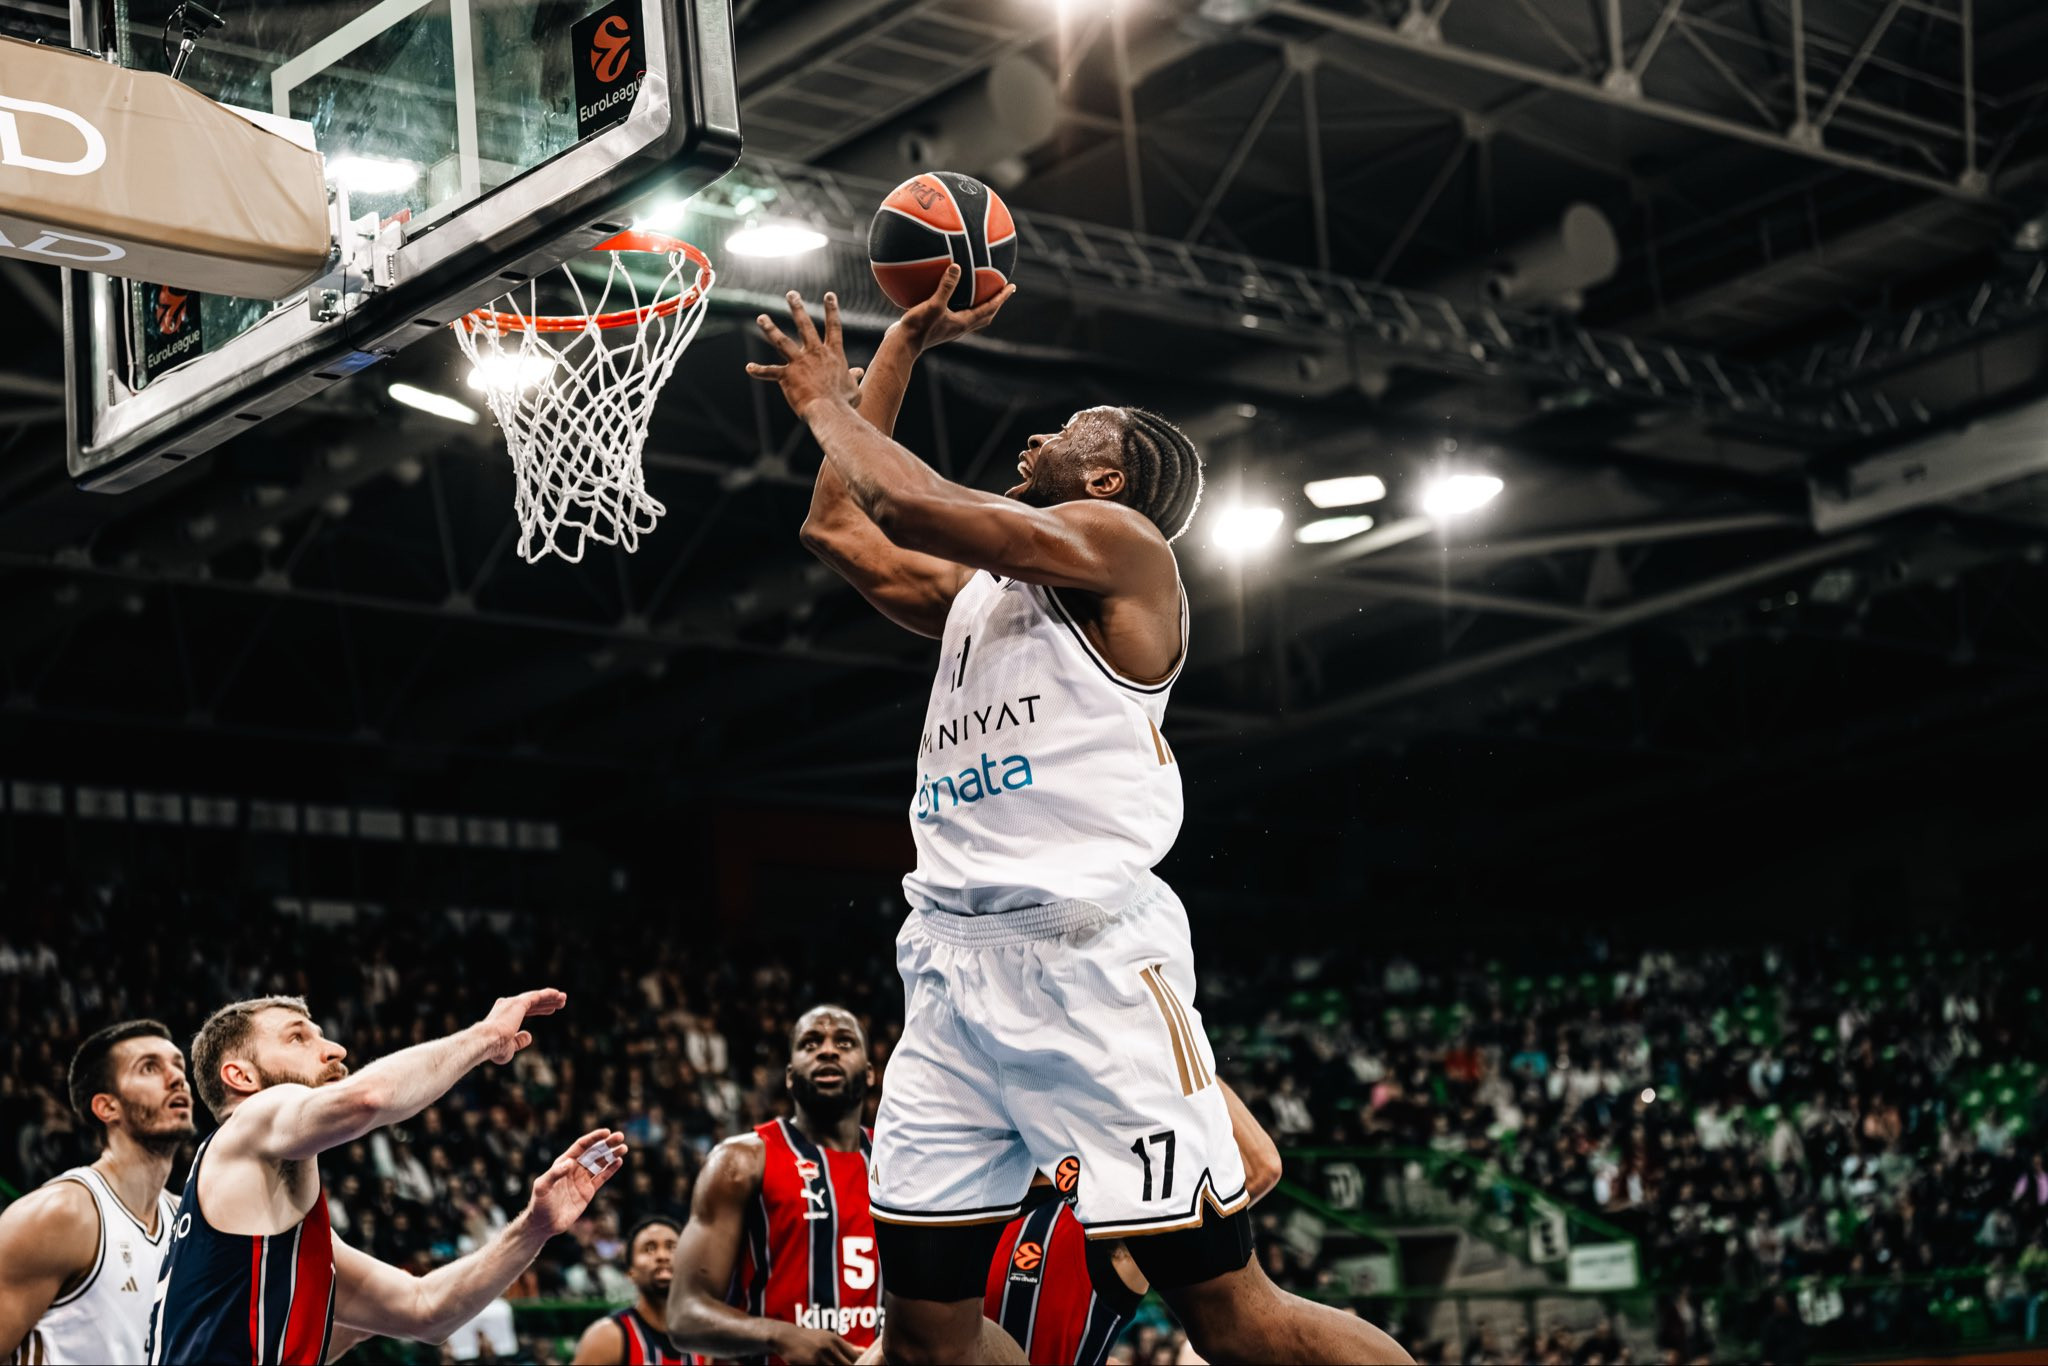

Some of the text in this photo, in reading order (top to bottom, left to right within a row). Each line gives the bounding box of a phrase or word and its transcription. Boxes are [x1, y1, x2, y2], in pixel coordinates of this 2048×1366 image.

[580, 79, 642, 122] EuroLeagu
[147, 329, 201, 369] EuroLeague
[1130, 1130, 1176, 1202] 17
[842, 1236, 876, 1290] 5
